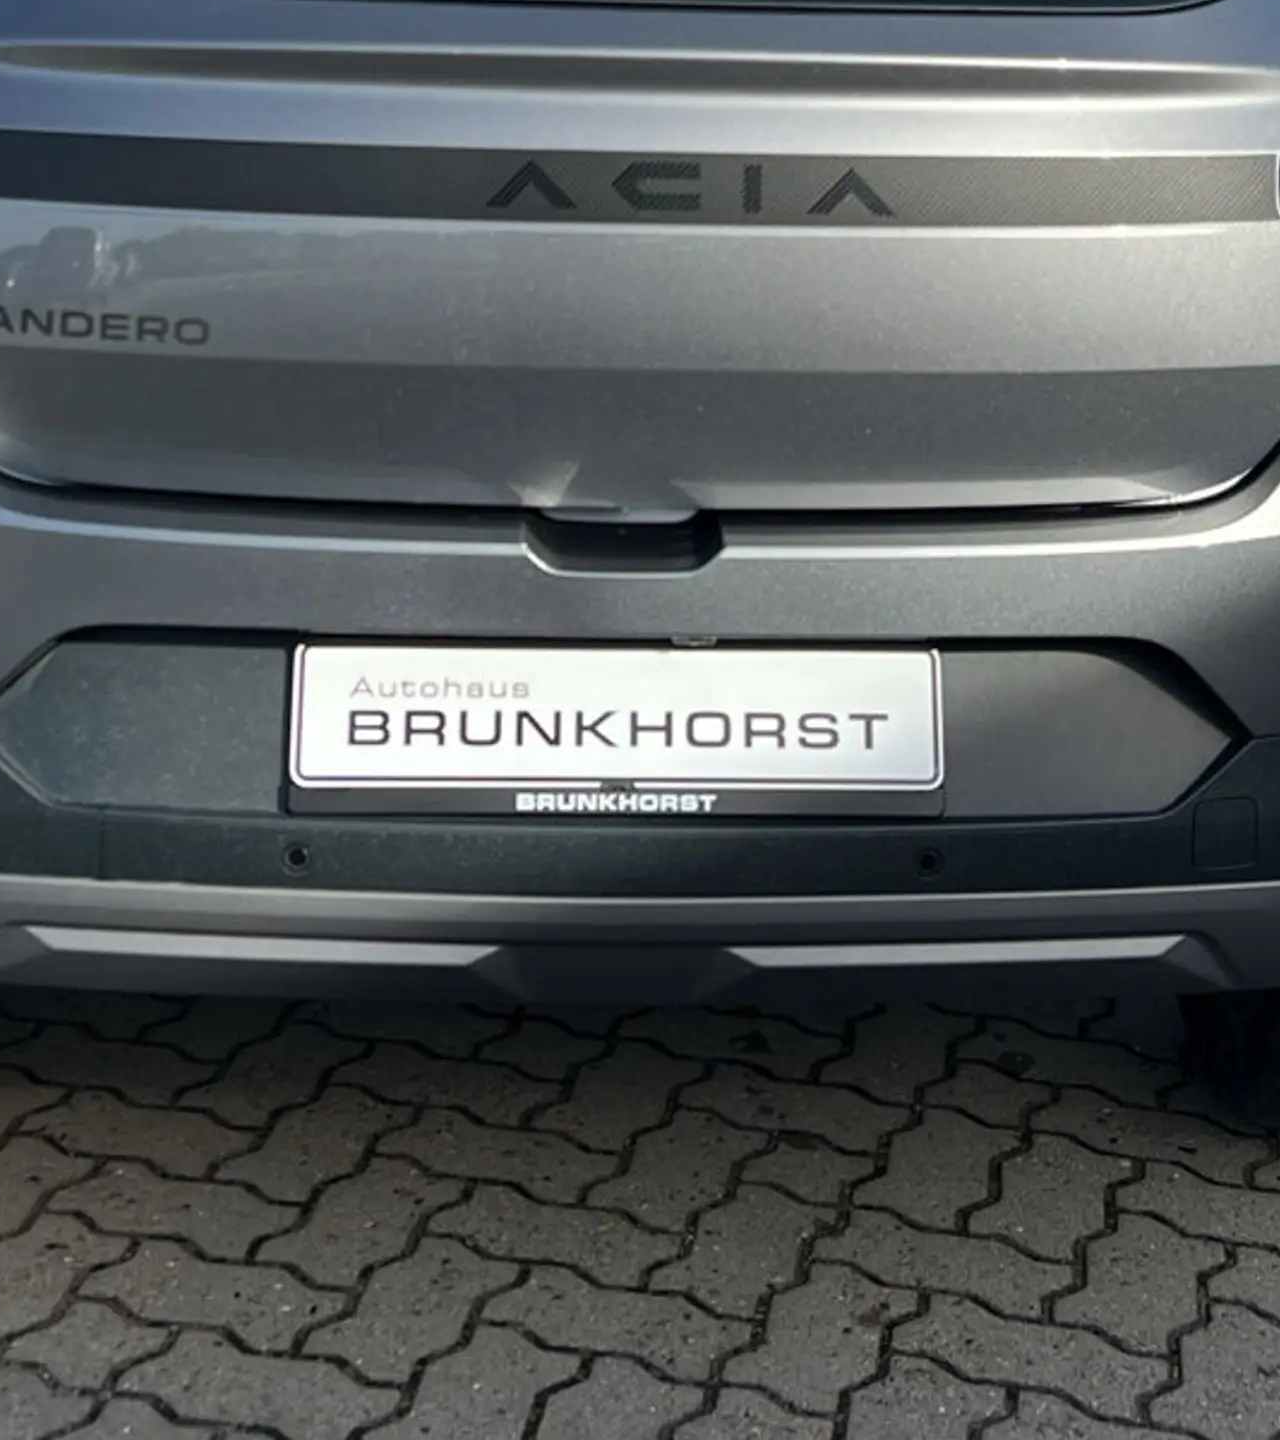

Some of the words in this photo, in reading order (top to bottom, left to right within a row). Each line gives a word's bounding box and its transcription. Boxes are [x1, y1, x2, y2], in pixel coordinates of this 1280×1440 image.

[349, 676, 531, 699] Autohaus
[347, 709, 889, 750] BRUNKHORST
[515, 791, 718, 814] BRUNKHORST
